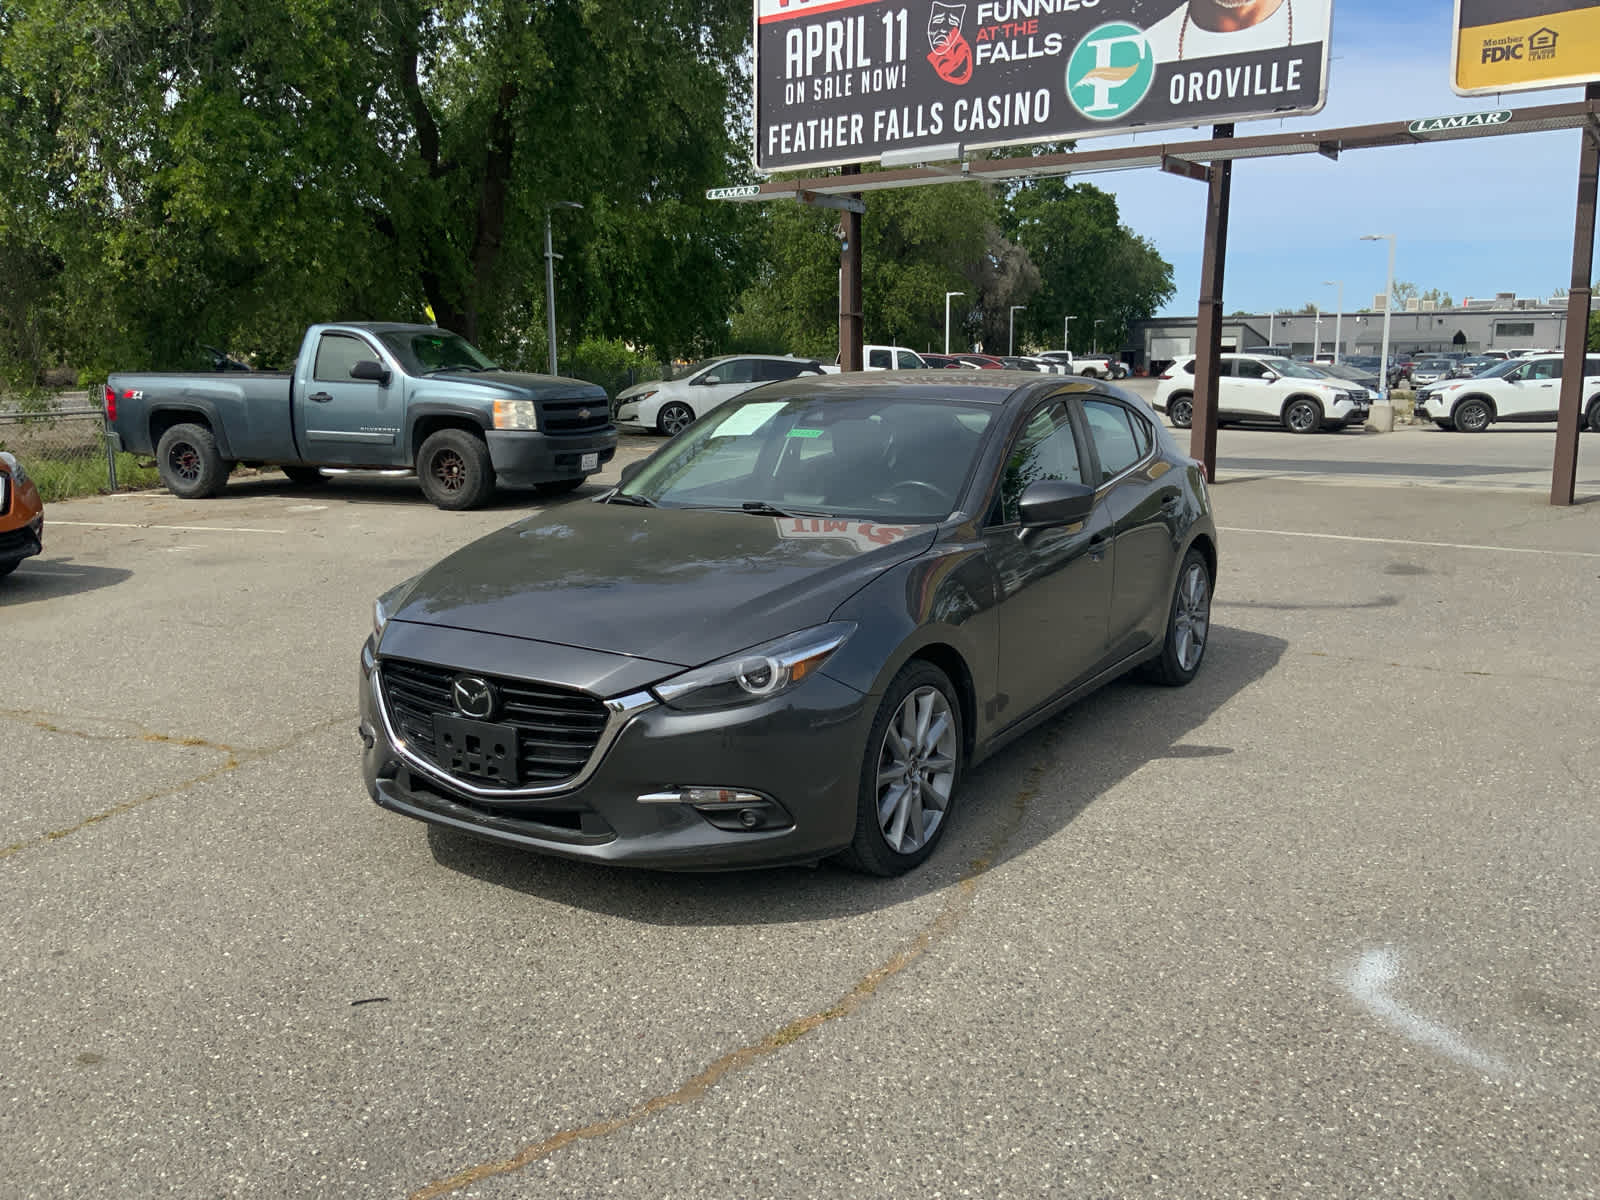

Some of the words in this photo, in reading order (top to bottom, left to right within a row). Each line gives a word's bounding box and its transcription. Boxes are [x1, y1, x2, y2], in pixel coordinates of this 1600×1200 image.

[785, 15, 872, 79] APRIL
[882, 8, 908, 63] 11
[976, 24, 1000, 42] AT
[1001, 19, 1039, 39] THE
[1483, 35, 1524, 47] Member
[976, 33, 1063, 66] FALLS
[1481, 43, 1524, 65] FDIC
[785, 82, 805, 105] ON
[814, 73, 853, 101] SALE
[861, 65, 907, 94] NOW!
[1169, 59, 1304, 105] OROVILLE
[769, 114, 864, 156] FEATHER
[873, 102, 944, 142] FALLS
[953, 88, 1051, 133] CASINO
[1417, 112, 1501, 131] LAMAR
[711, 186, 755, 199] LAMAR
